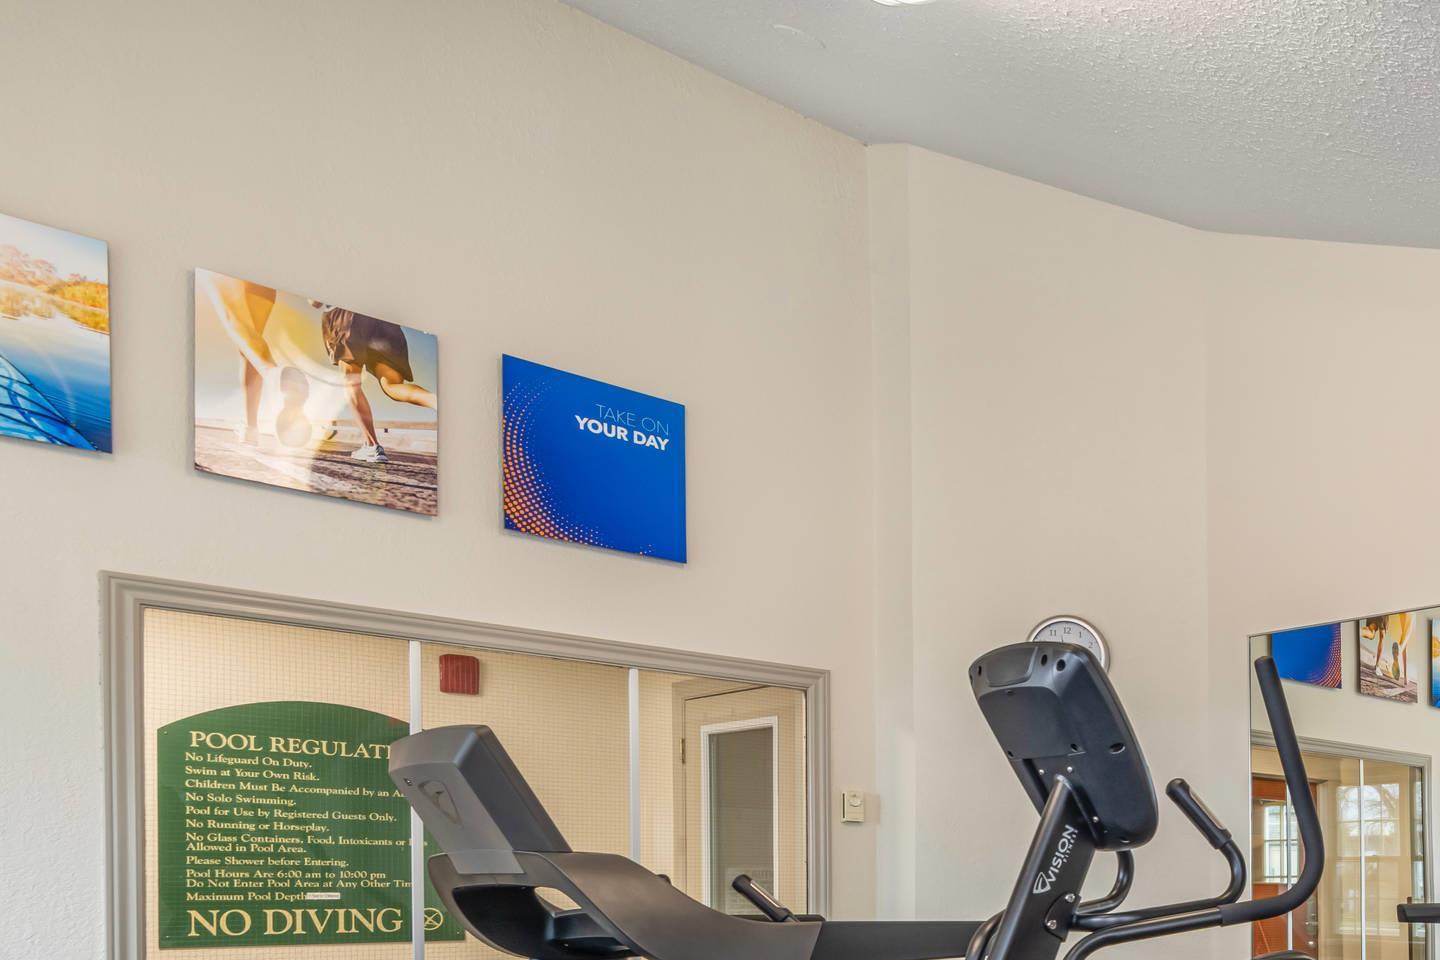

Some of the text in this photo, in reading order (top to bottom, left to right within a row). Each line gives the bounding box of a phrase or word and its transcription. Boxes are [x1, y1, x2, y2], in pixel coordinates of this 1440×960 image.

[596, 404, 670, 436] TAKE ON
[574, 415, 670, 451] YOUR DAY
[1064, 626, 1072, 634] 12
[189, 731, 391, 760] POOL REGULATI
[185, 752, 312, 769] No Lifeguard On Duty.
[185, 766, 216, 776] Swim
[235, 768, 260, 778] Your
[263, 770, 289, 779] Own
[293, 772, 320, 781] Risk.
[185, 779, 235, 789] Children
[240, 782, 268, 790] Must
[272, 783, 286, 792] Be
[290, 785, 359, 796] Accompanied
[363, 788, 374, 798] by
[185, 792, 296, 806] No Solo Swimming.
[185, 806, 397, 822] Pool for Use by Registered Guests Only.
[186, 819, 203, 828] No
[208, 820, 256, 831] Running
[274, 820, 330, 832] Horseplay.
[186, 832, 203, 841] No
[207, 833, 237, 842] Glass
[308, 836, 335, 845] Food,
[339, 836, 392, 845] Intoxicants
[186, 842, 232, 851] Allowed
[251, 844, 274, 852] Pool
[278, 844, 306, 852] Area.
[1048, 824, 1074, 882] VISION
[186, 856, 349, 867] Please Shower before Entering.
[186, 869, 211, 878] Pool
[215, 870, 250, 878] Hours
[277, 870, 302, 878] 6:00
[186, 879, 204, 887] Do
[336, 880, 358, 888] Any
[186, 892, 244, 900] Maximum
[248, 892, 271, 900] Pool
[275, 892, 306, 902] Depth
[186, 908, 403, 936] NO DIVING
